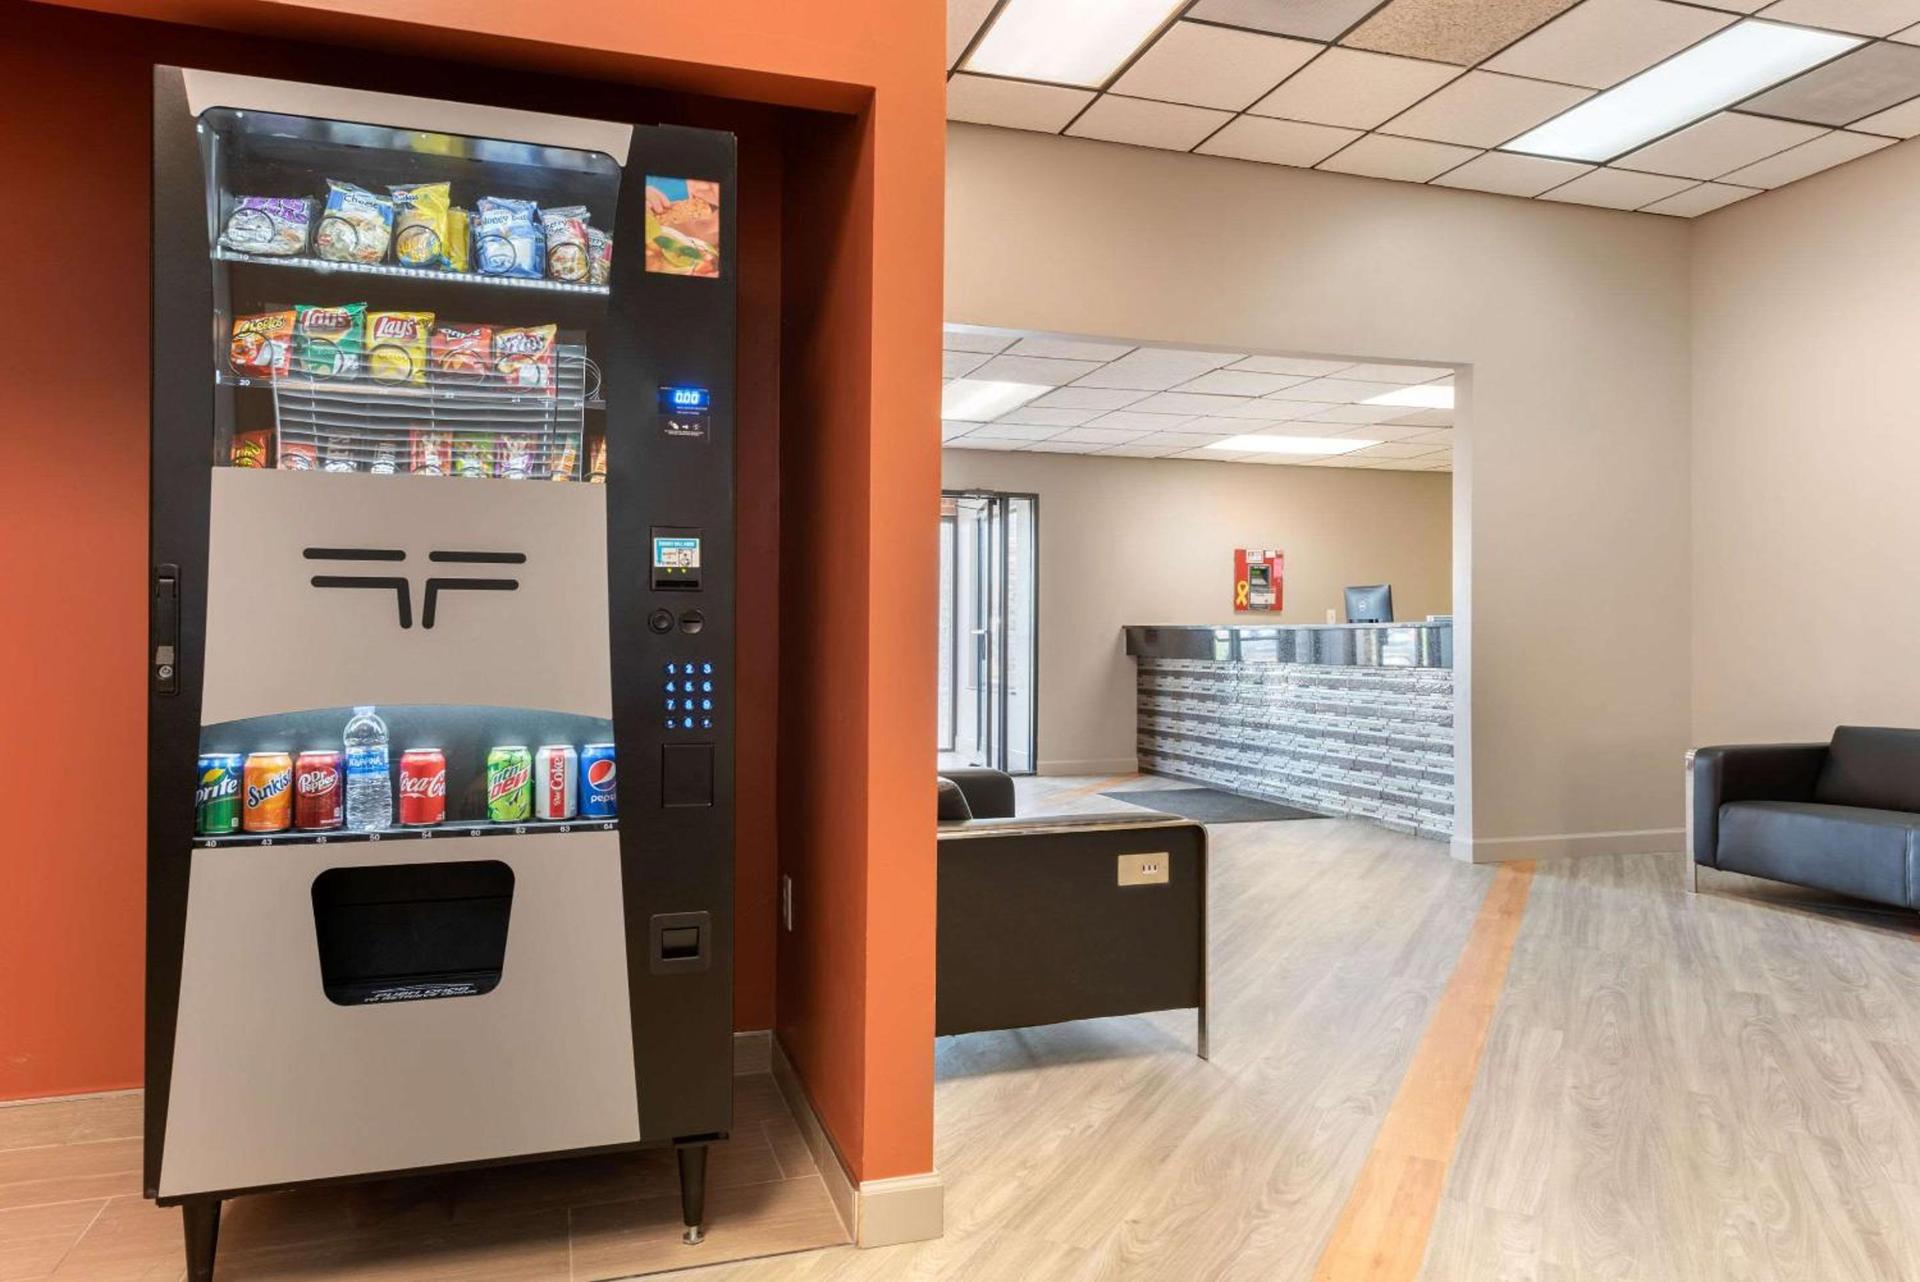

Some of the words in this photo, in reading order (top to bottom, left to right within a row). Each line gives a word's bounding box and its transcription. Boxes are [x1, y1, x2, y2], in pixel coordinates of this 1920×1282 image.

[376, 316, 415, 338] Lay's
[667, 664, 675, 674] 1
[685, 664, 694, 674] 2
[703, 664, 712, 674] 3
[667, 682, 675, 692] 4
[685, 682, 694, 692] 5
[703, 682, 712, 692] 6
[667, 700, 675, 711] 7
[685, 700, 694, 711] 8
[703, 700, 712, 711] 9
[311, 771, 328, 783] Dr
[551, 756, 564, 790] Coke
[247, 768, 292, 809] Sunkist
[298, 774, 336, 793] Pepper
[195, 775, 238, 808] prite
[205, 840, 217, 848] 40
[261, 838, 273, 846] 43
